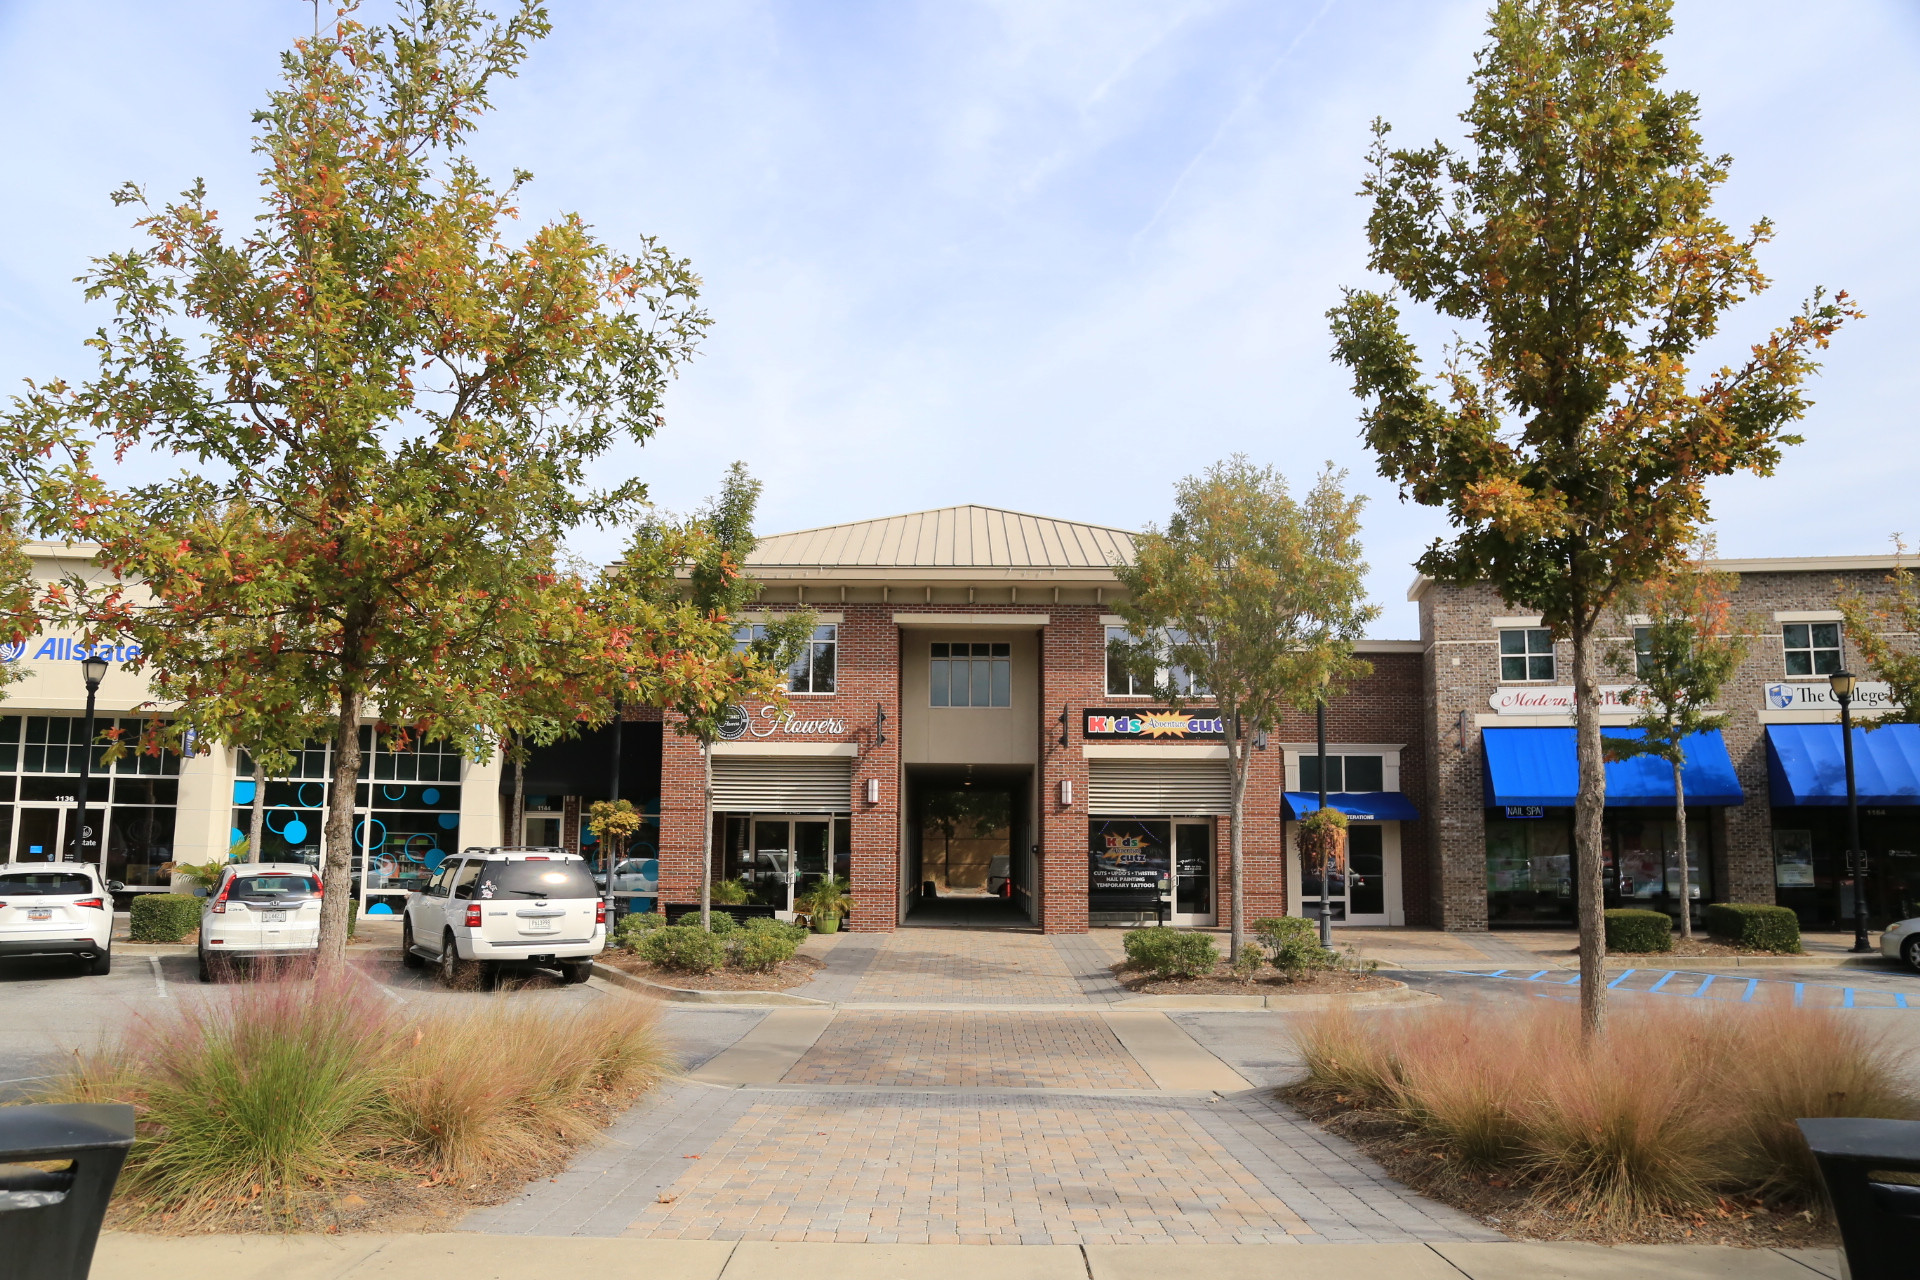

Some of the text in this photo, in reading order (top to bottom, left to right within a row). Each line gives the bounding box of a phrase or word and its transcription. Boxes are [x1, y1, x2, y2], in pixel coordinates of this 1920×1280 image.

[1502, 692, 1567, 706] Modern
[1797, 687, 1825, 702] The
[1829, 687, 1886, 706] Cllege
[750, 705, 846, 737] Flowers
[1088, 716, 1232, 734] Kids Adventure cut
[1507, 806, 1542, 816] NAIL SPA
[1106, 837, 1139, 848] Kids
[1119, 854, 1147, 863] cutz
